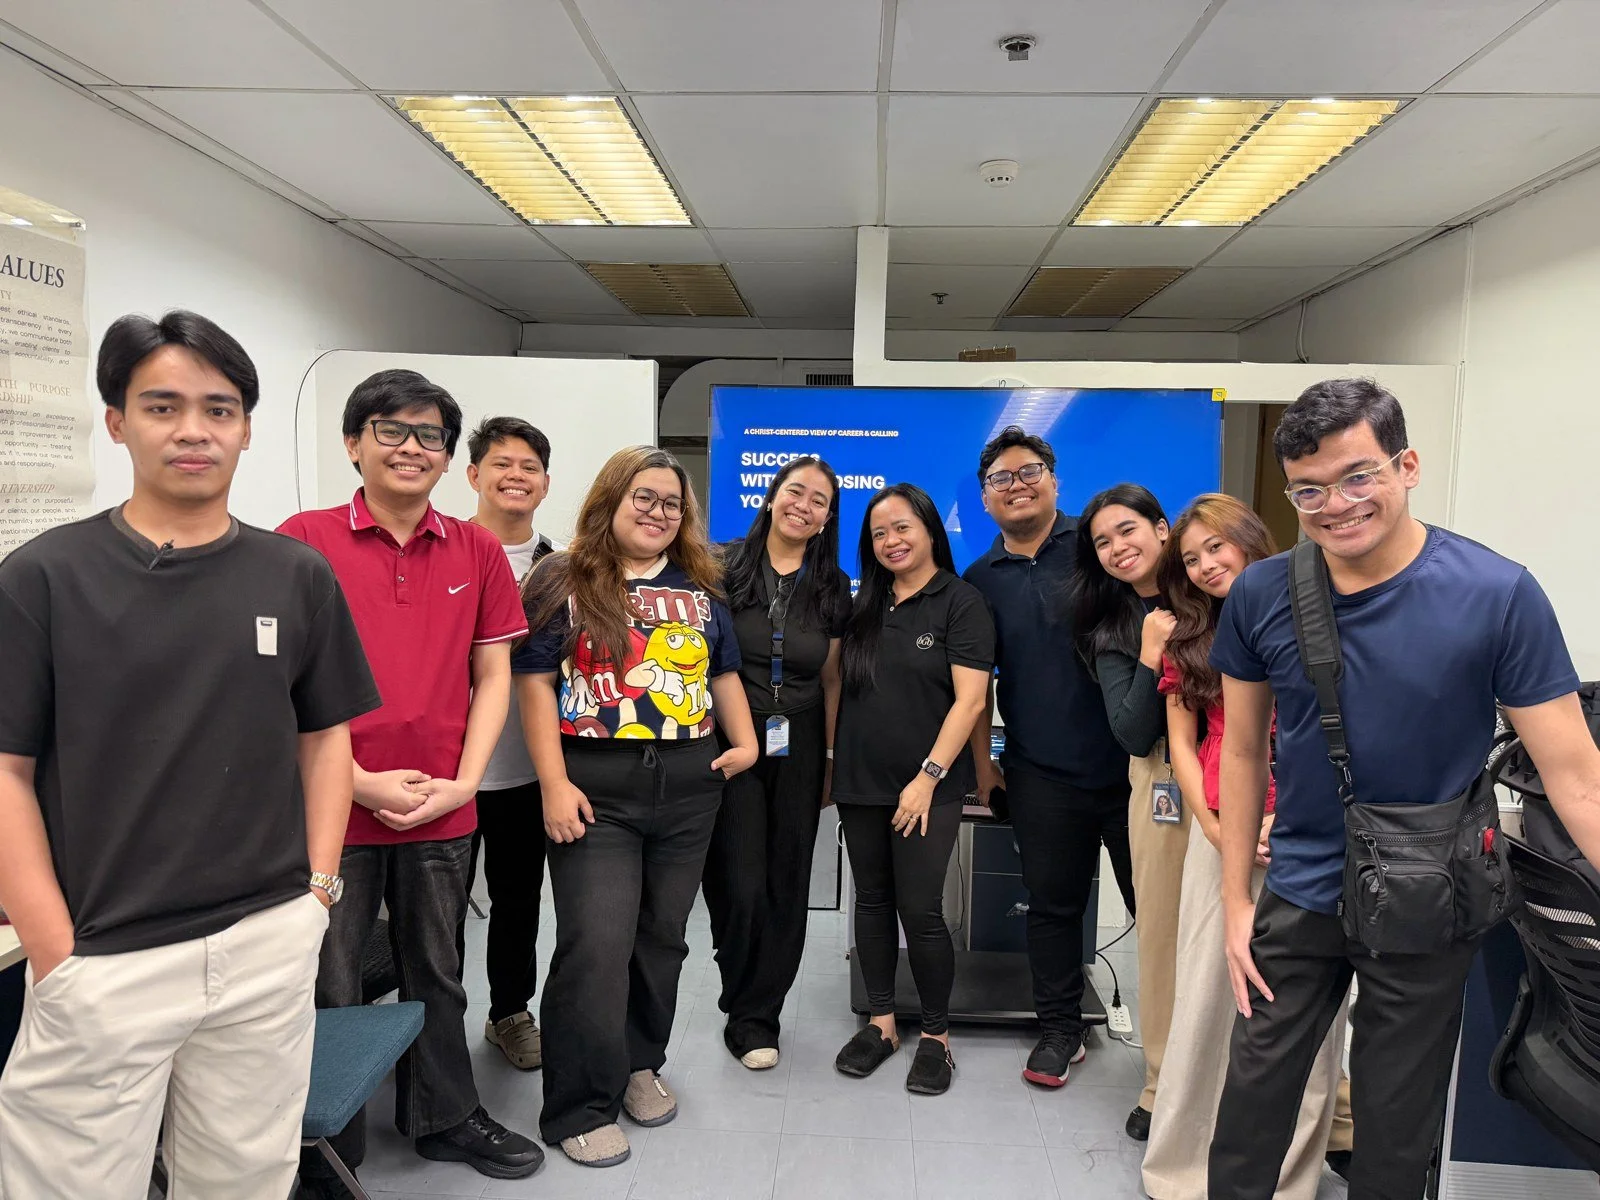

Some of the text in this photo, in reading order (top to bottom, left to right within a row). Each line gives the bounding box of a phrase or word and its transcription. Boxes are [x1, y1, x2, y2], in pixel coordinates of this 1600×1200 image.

[20, 331, 58, 342] communicate
[57, 328, 72, 336] every
[29, 382, 71, 397] PURPOSE
[10, 419, 56, 429] professionalism
[749, 428, 810, 436] CHRIST-CENTERED
[4, 440, 39, 449] opportunity
[50, 443, 72, 451] treating
[740, 494, 767, 509] YO
